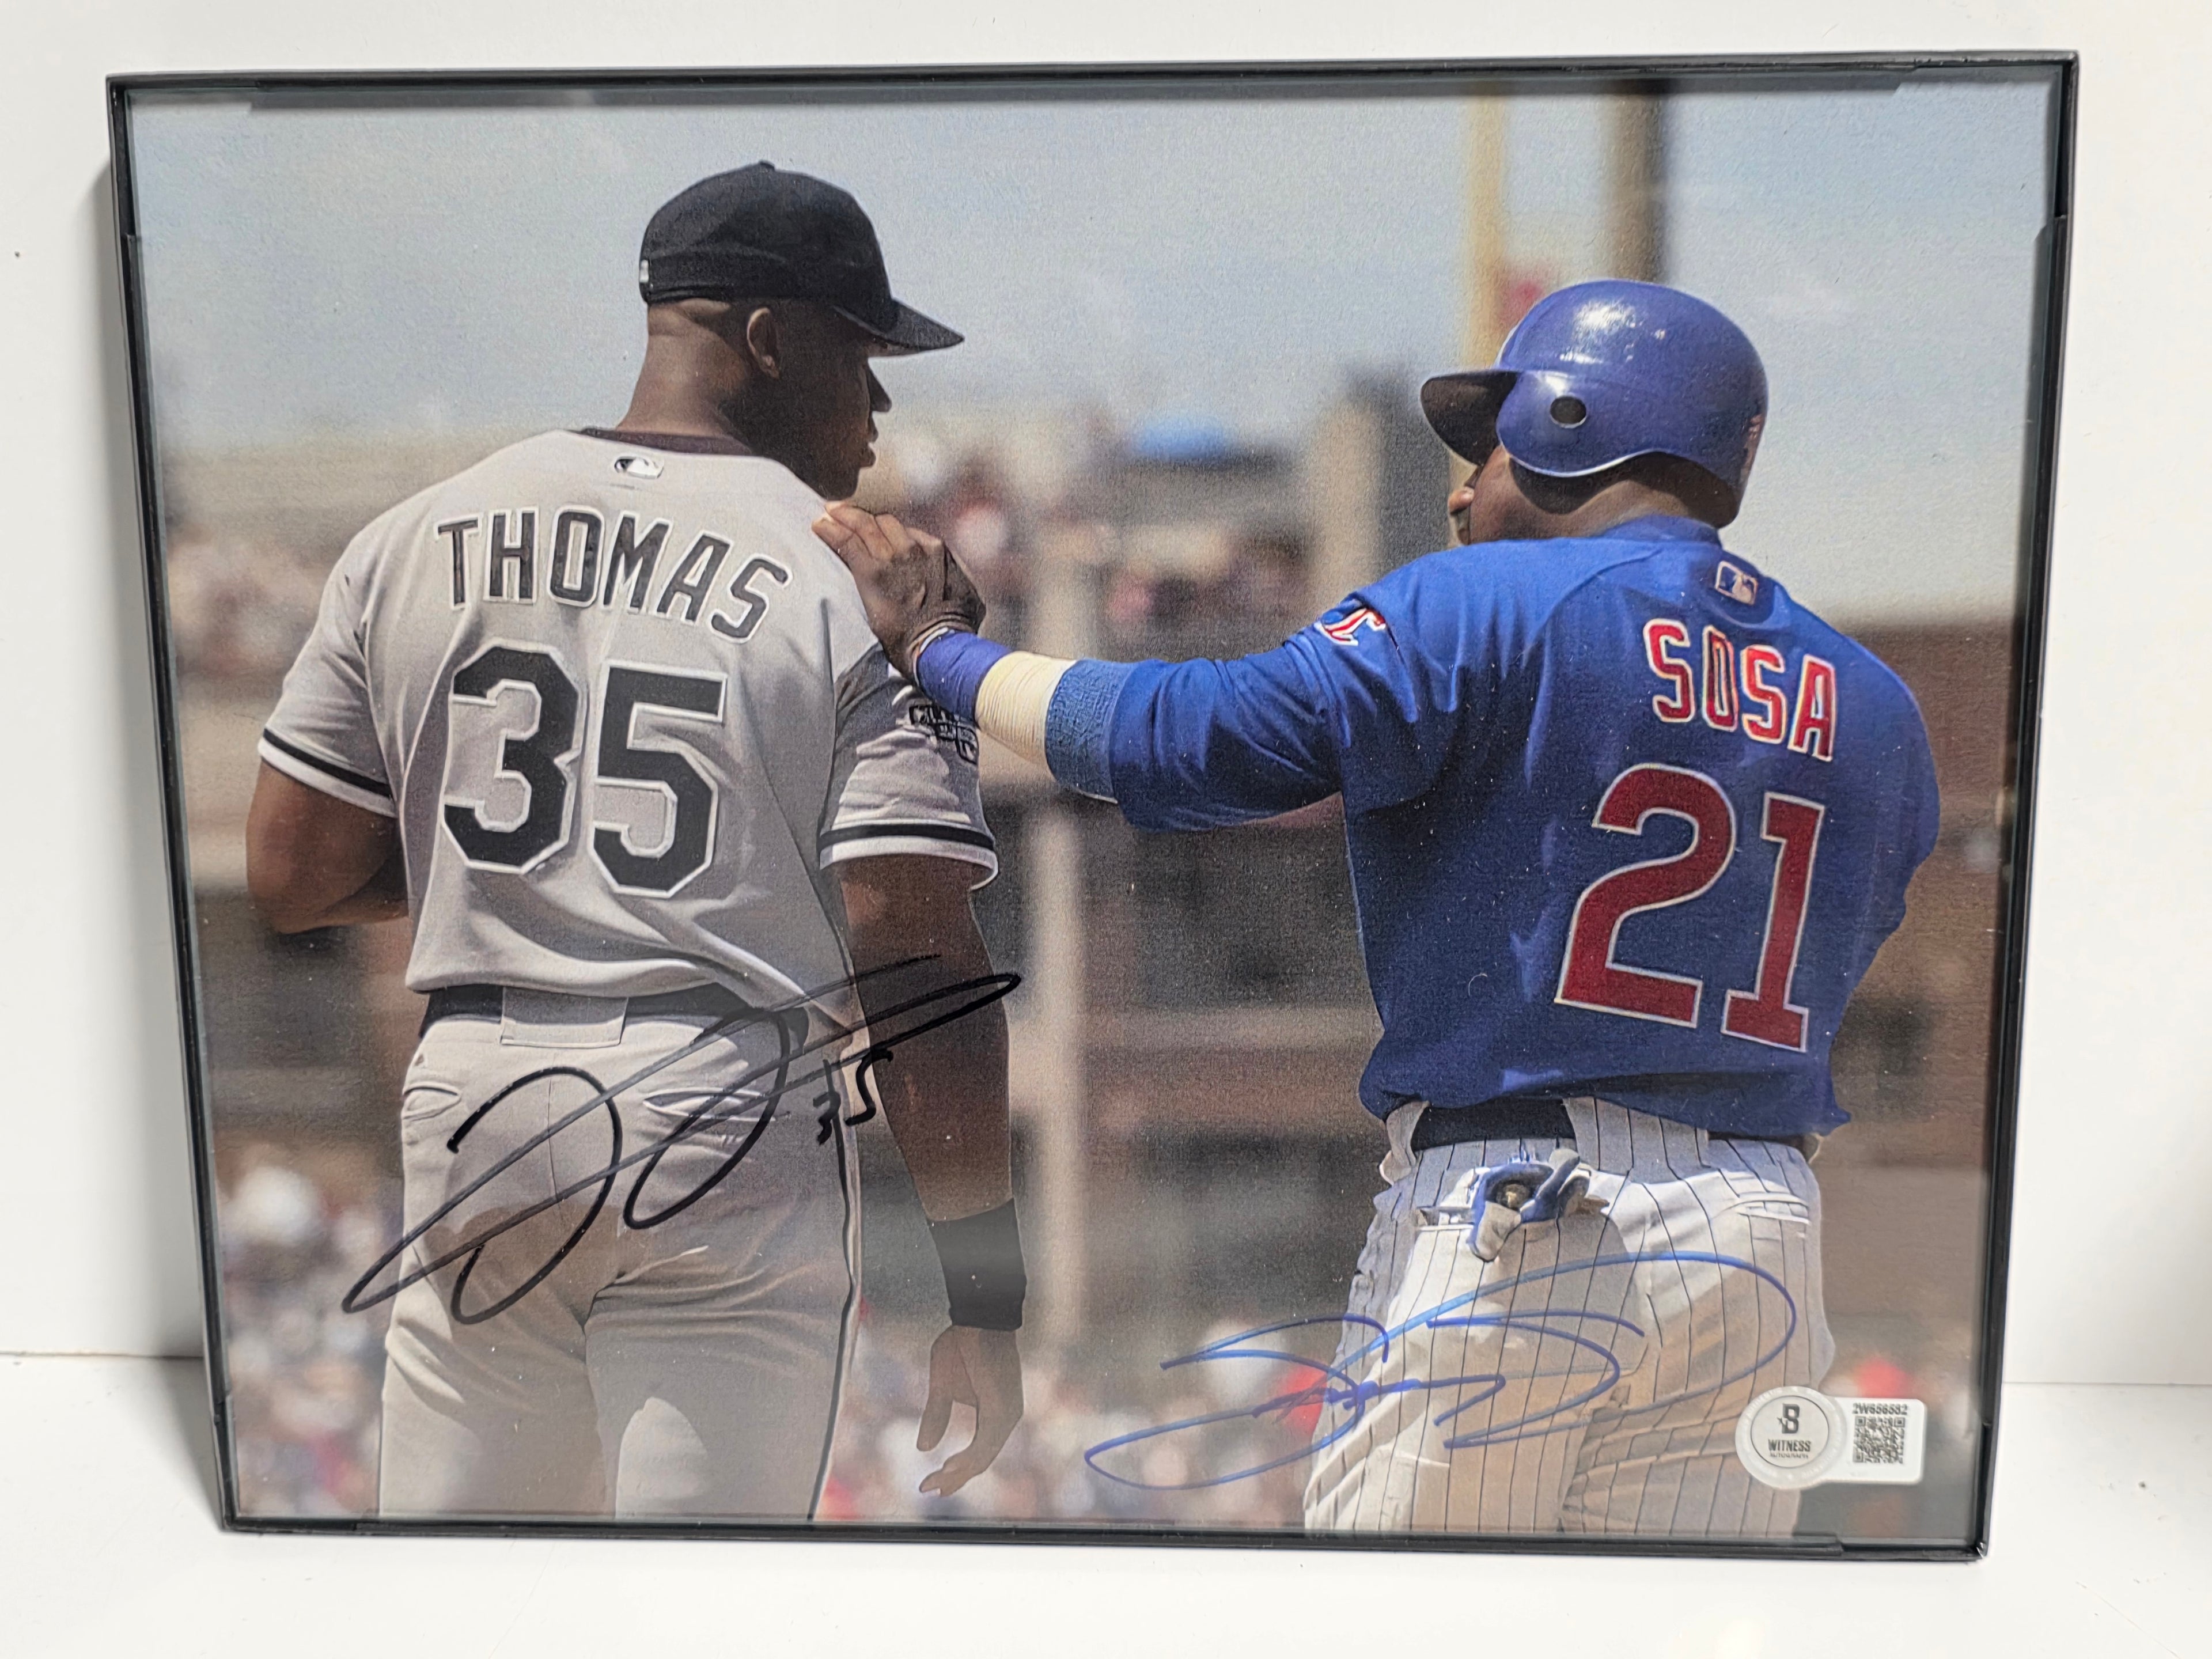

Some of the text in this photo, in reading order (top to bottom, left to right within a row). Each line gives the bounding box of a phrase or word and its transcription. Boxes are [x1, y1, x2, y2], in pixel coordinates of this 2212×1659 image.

[433, 505, 793, 643] THOMAS
[1643, 618, 1837, 762] SOSA
[441, 638, 728, 899] 35
[1554, 762, 1825, 1054] 21
[1767, 1439, 1812, 1452] WITNESS
